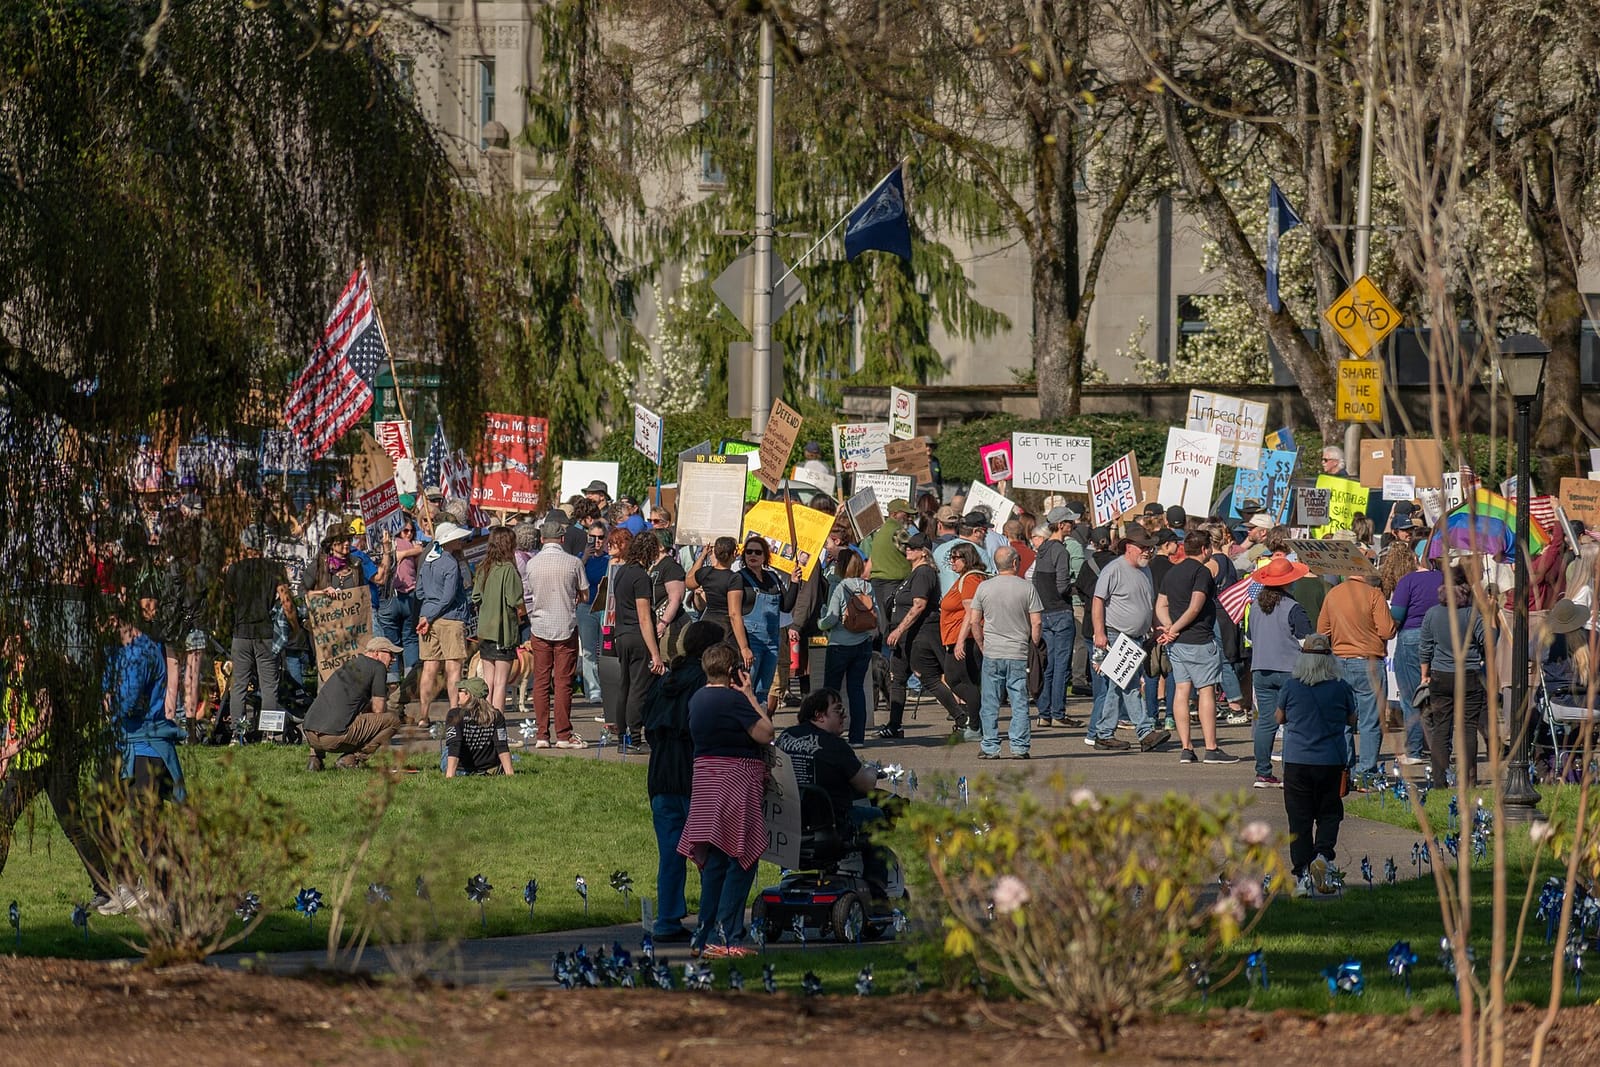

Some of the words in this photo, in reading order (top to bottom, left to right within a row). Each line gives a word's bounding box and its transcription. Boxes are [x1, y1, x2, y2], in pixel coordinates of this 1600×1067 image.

[1342, 367, 1379, 379] SHARE
[1350, 385, 1370, 397] THE
[897, 399, 908, 411] STOP
[1190, 395, 1254, 429] Impeach
[1344, 402, 1375, 414] ROAD
[775, 402, 800, 429] DEFEND
[512, 421, 544, 433] Msk
[1215, 423, 1257, 441] REMOVE
[500, 434, 515, 444] got
[1018, 436, 1039, 447] GET
[1045, 437, 1062, 447] THE
[1066, 439, 1090, 448] HORSE
[696, 454, 705, 463] NO
[708, 455, 727, 464] KINGS
[1036, 452, 1058, 461] OUT
[1062, 453, 1077, 461] OF
[1174, 449, 1215, 466] REMOVE
[1042, 463, 1063, 471] THE
[1167, 461, 1200, 478] TRUMP
[1023, 471, 1089, 487] HOSPITAL
[1092, 457, 1129, 496] USAID
[362, 493, 381, 511] STOP
[383, 484, 398, 499] THE
[1096, 477, 1131, 508] SAVES
[1299, 488, 1305, 497] I
[1306, 488, 1316, 498] AM
[1318, 488, 1327, 498] SO
[363, 496, 400, 521] NONSENSE
[1098, 492, 1134, 524] LIVES
[1293, 541, 1350, 553] HANDS
[331, 640, 358, 657] RICH
[320, 654, 359, 671] INST
